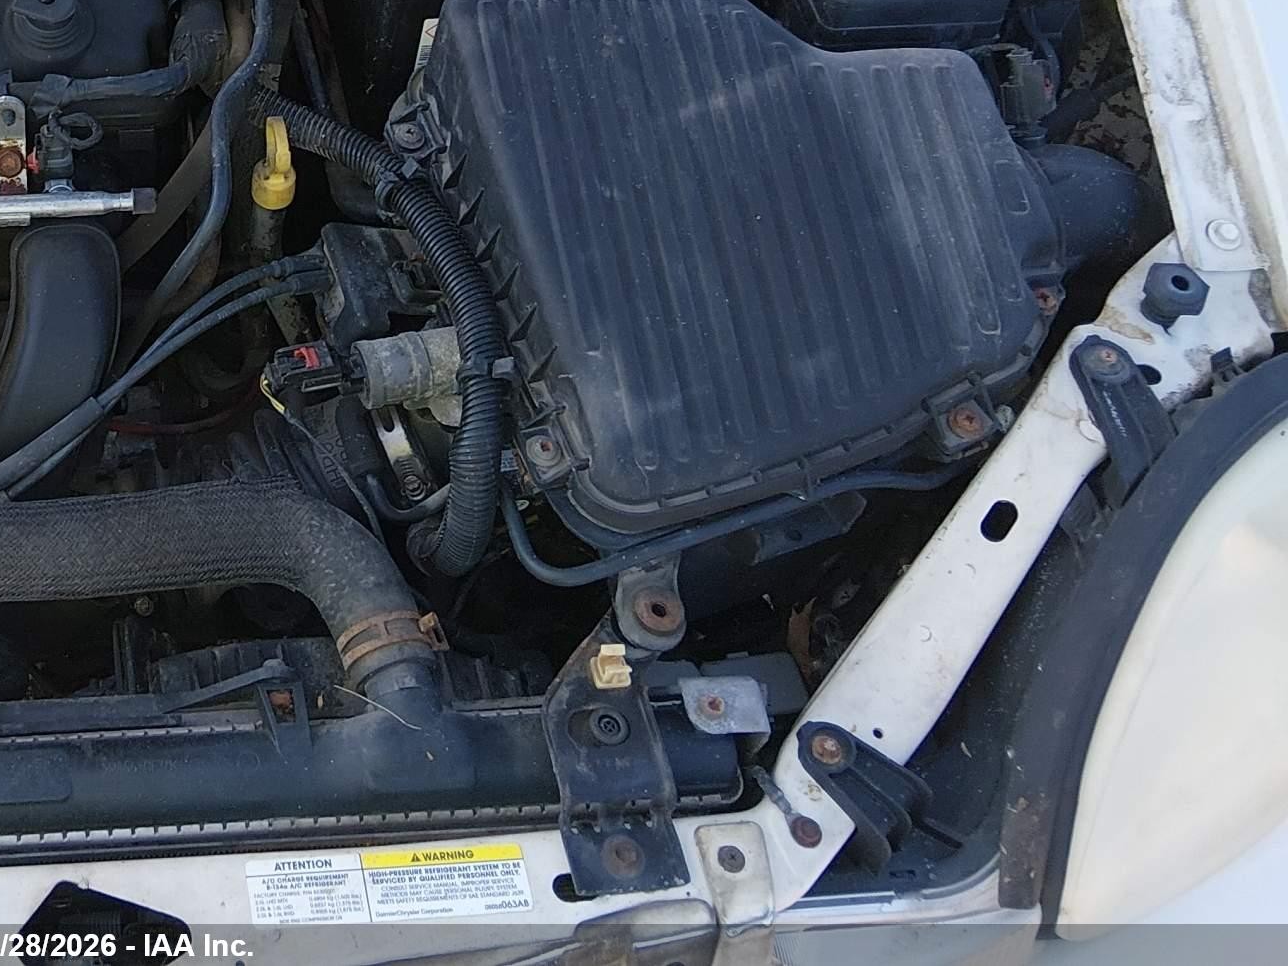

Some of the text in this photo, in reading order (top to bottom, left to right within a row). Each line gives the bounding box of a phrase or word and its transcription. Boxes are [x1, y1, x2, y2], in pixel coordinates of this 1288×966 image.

[422, 850, 474, 862] WARNING
[274, 859, 333, 872] ATTENTION
[368, 868, 423, 878] HIGH-PRESSURE
[424, 865, 471, 875] REFRIGERANT
[474, 863, 499, 872] SYSTEM
[513, 861, 521, 869] BE
[372, 876, 406, 885] SERVICED
[419, 874, 455, 882] QUALIFIED
[457, 871, 499, 879] PERSONNEL
